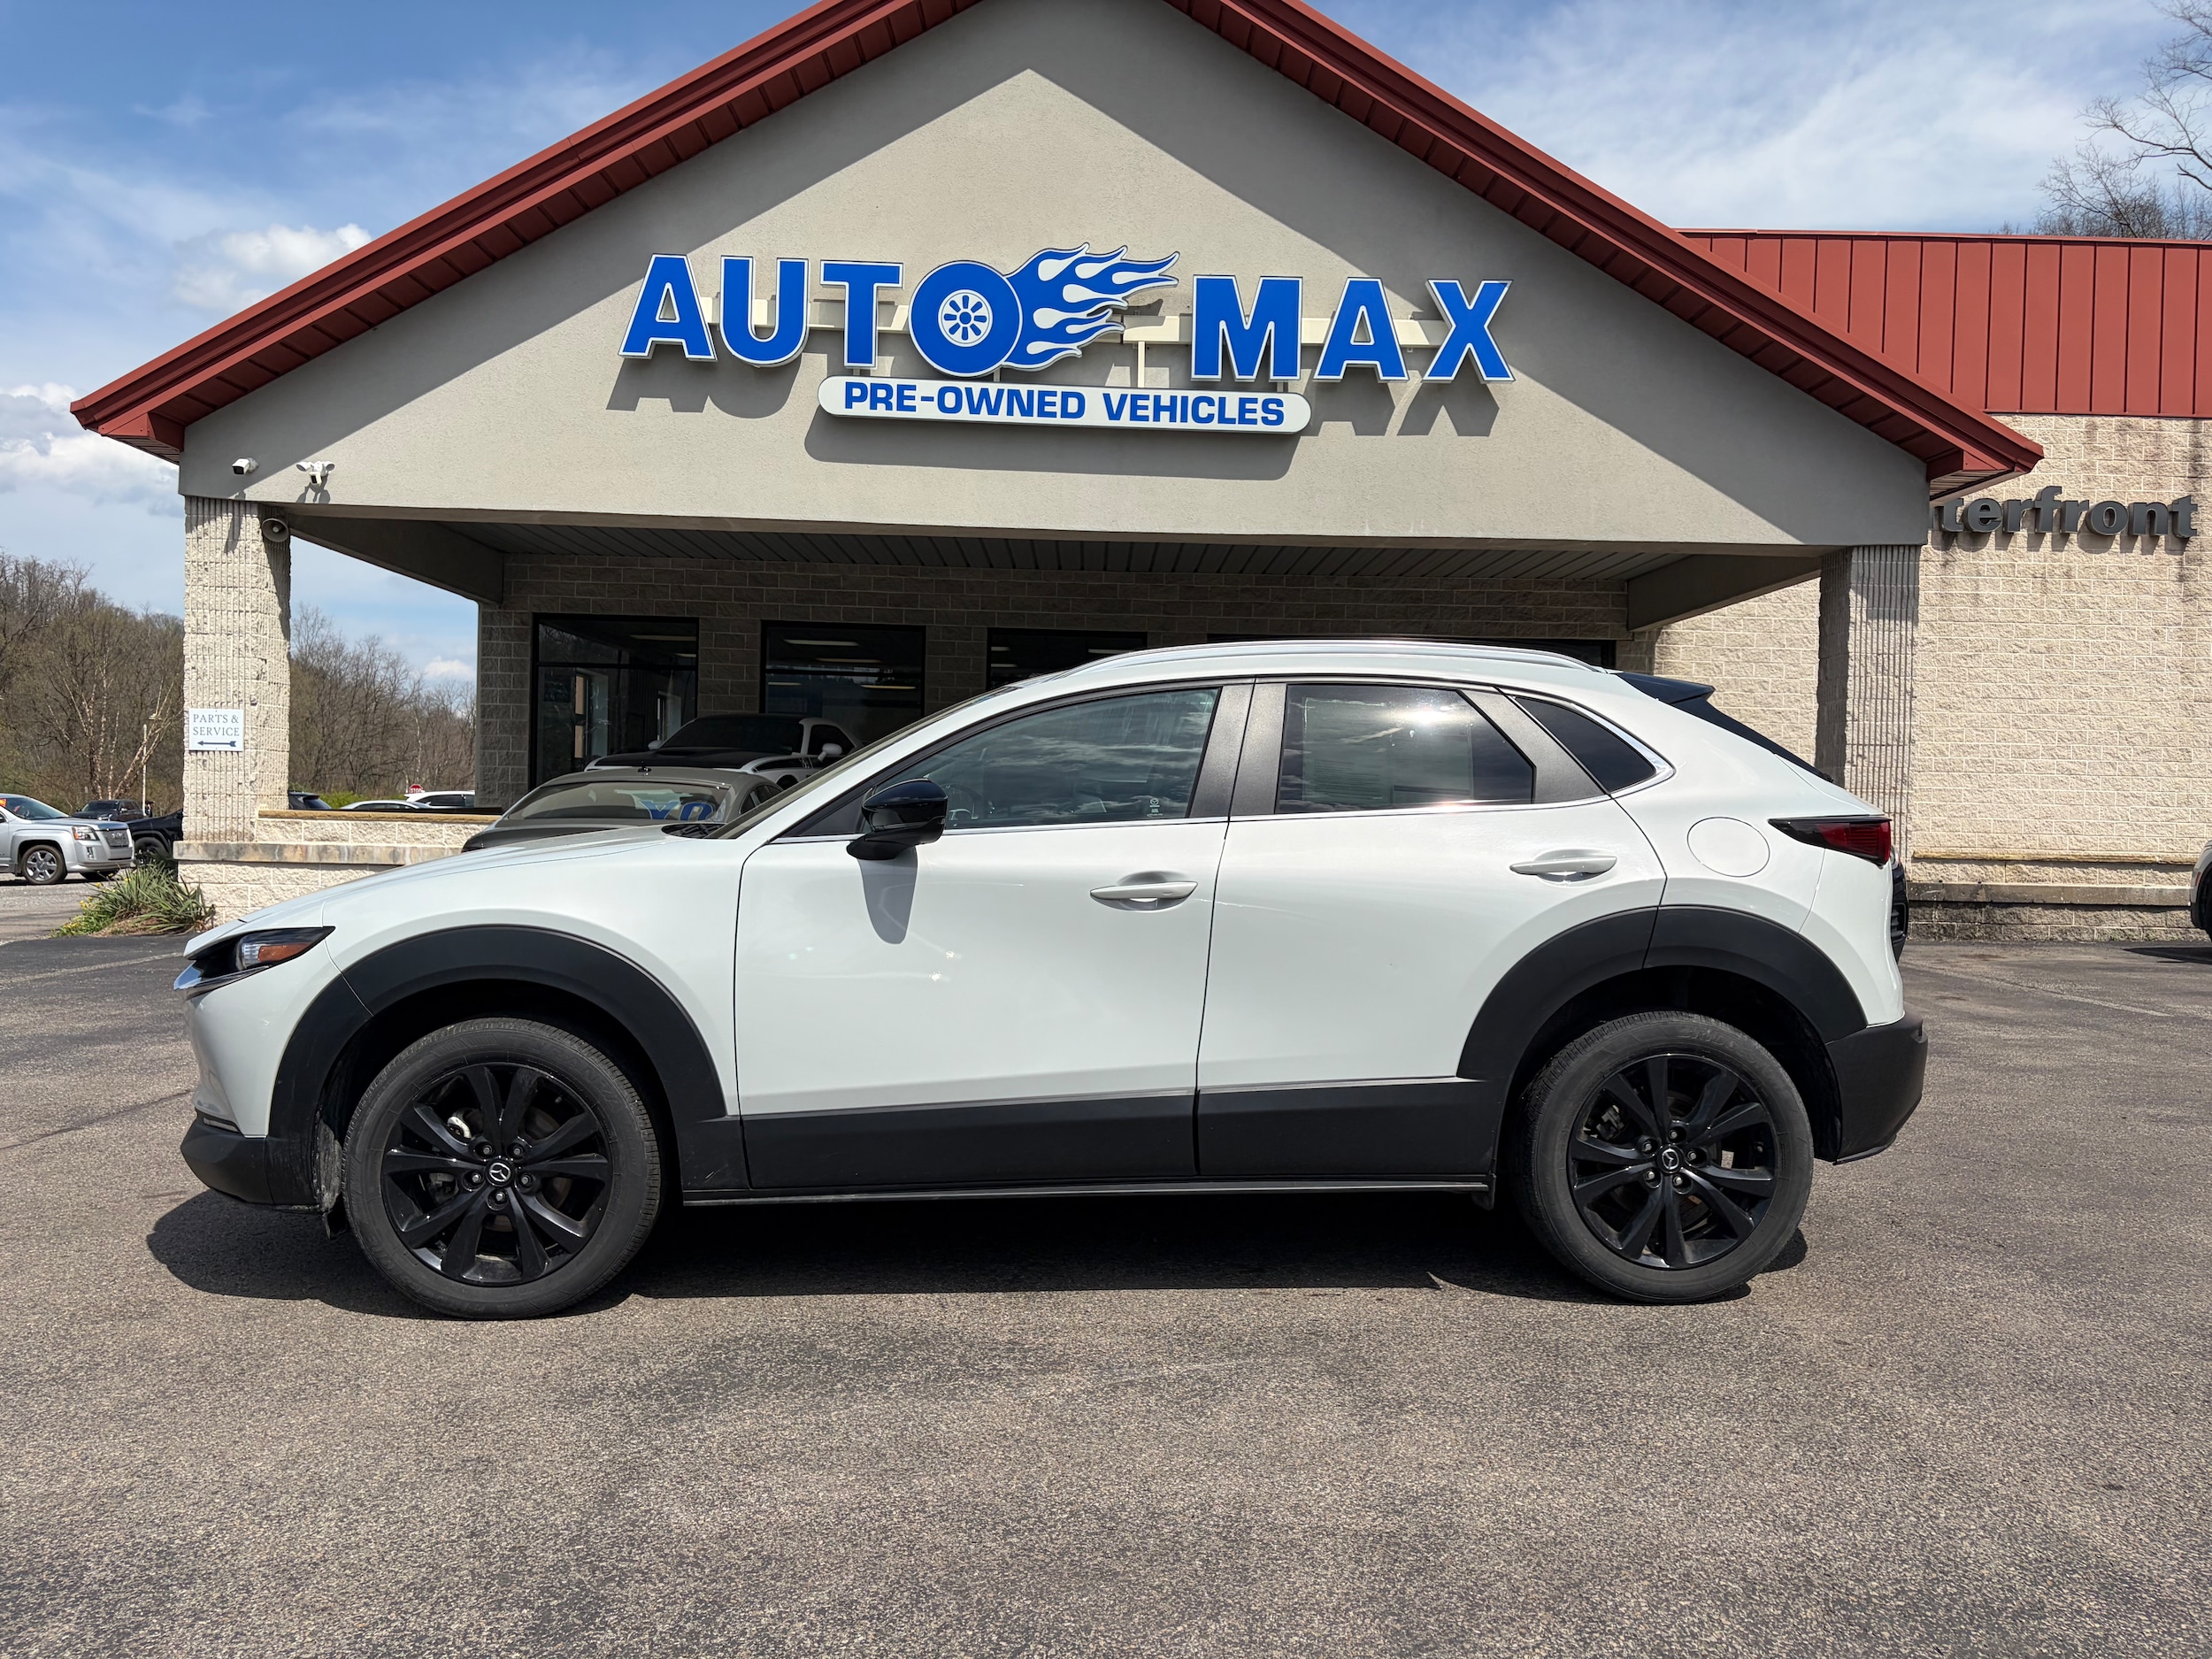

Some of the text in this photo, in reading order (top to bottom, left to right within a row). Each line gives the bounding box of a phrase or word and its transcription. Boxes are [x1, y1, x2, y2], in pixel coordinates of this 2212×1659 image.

[619, 253, 1516, 383] AUTO MAX
[843, 380, 1286, 426] PRE-OWNED VEHICLES
[1930, 485, 2198, 538] terfront
[192, 726, 240, 736] SERVICE
[193, 713, 239, 724] PARTS &
